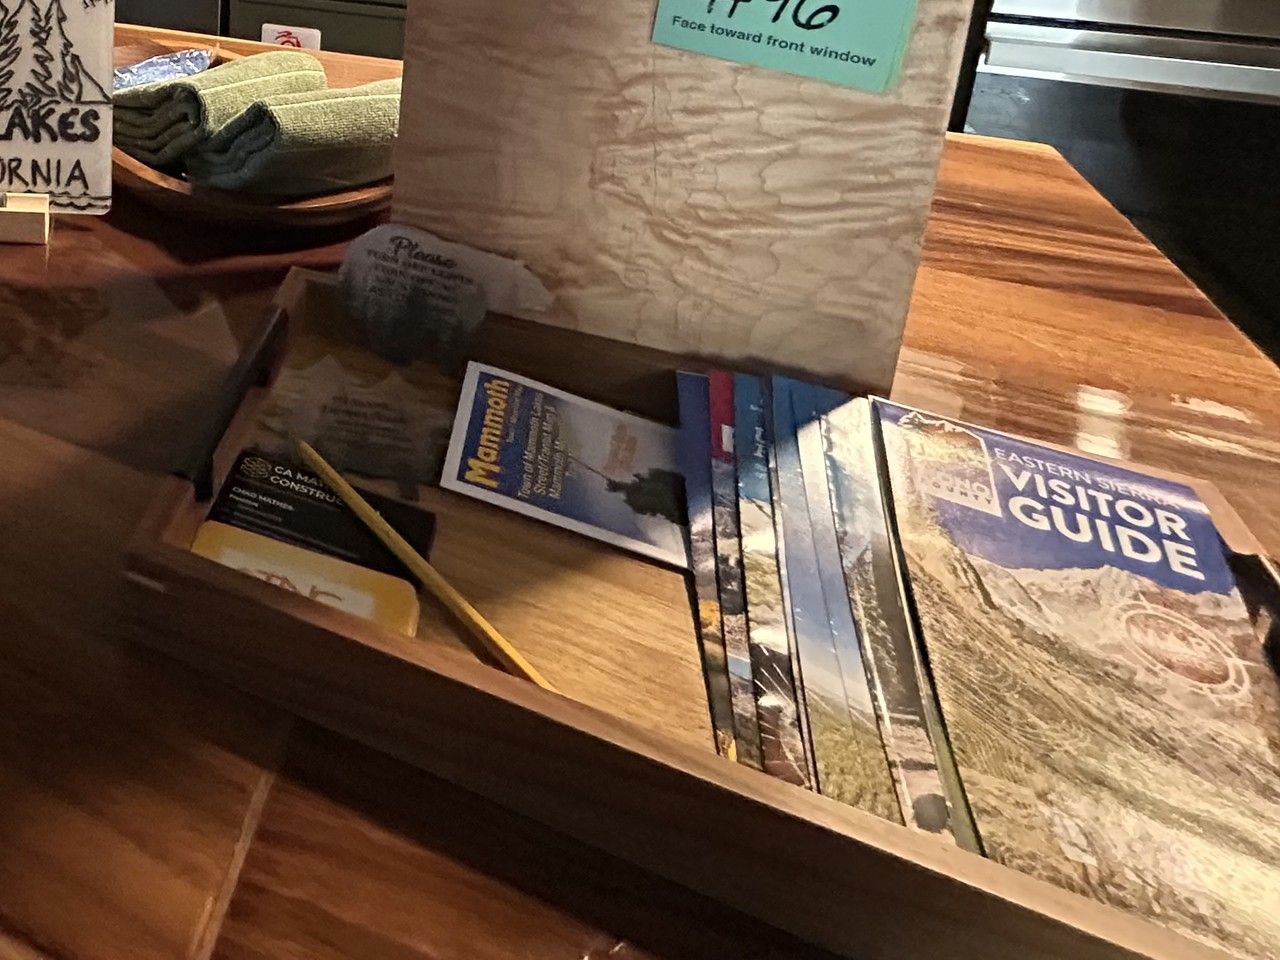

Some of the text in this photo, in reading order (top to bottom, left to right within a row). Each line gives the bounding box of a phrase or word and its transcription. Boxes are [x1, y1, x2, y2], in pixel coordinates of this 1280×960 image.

[671, 15, 877, 67] Face toward front window
[388, 235, 458, 269] Please
[464, 378, 510, 488] Mammoth
[274, 464, 293, 479] CA
[932, 481, 992, 504] OUNTY
[994, 447, 1182, 509] EASTERN SIERRA
[998, 462, 1192, 541] VISITOR
[1008, 495, 1205, 581] GUIDE
